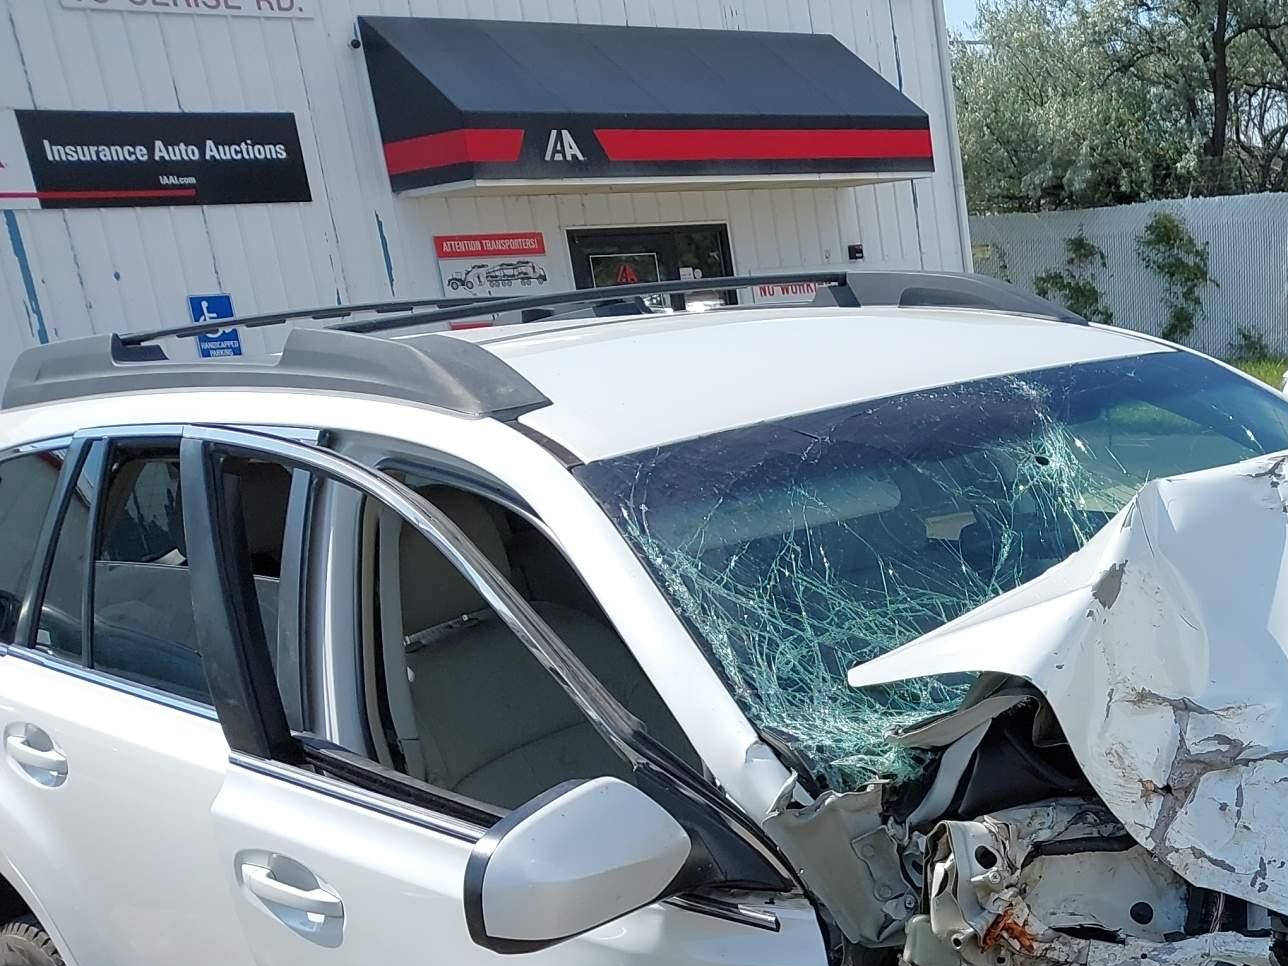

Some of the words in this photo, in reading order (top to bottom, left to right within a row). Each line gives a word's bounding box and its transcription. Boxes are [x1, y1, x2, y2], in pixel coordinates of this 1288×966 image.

[43, 139, 149, 161] Insurance
[154, 139, 199, 161] Auto
[205, 139, 287, 160] Auctions
[442, 240, 481, 252] ATTENTION
[482, 238, 539, 250] TRANSPORTERS!
